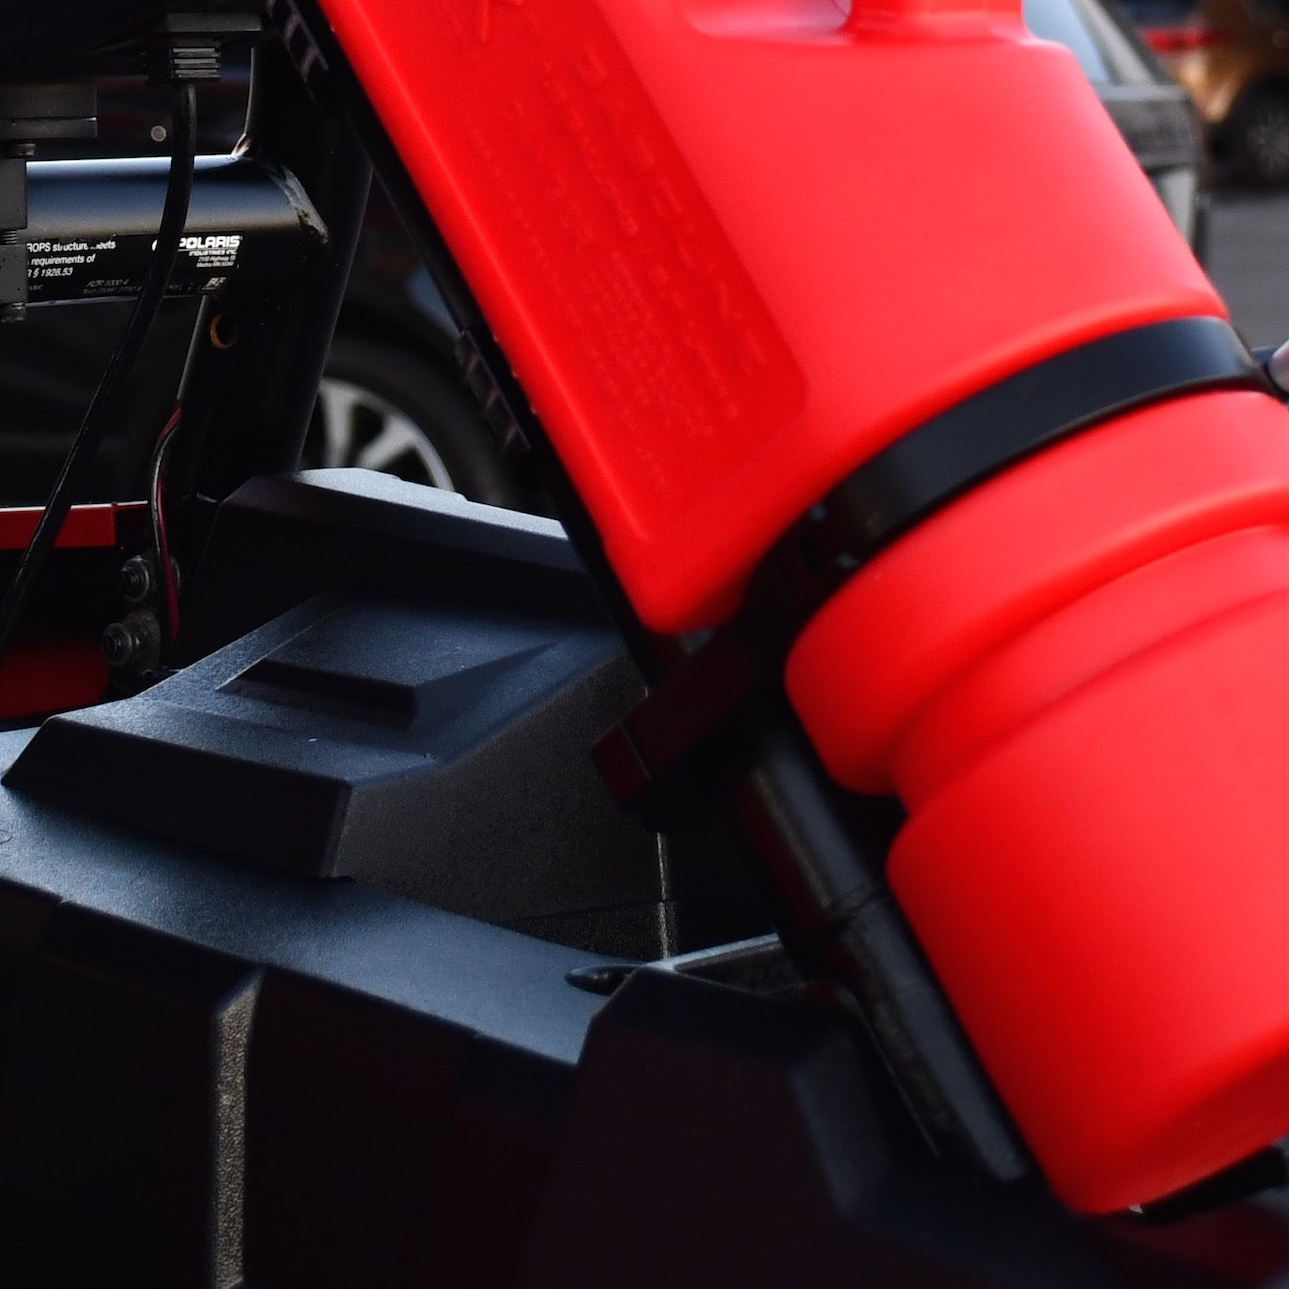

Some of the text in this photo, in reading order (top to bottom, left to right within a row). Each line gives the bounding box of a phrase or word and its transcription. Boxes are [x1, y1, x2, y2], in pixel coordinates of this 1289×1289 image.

[179, 235, 240, 249] POLARIS
[31, 253, 97, 267] requirements of
[41, 267, 73, 278] 1928.53
